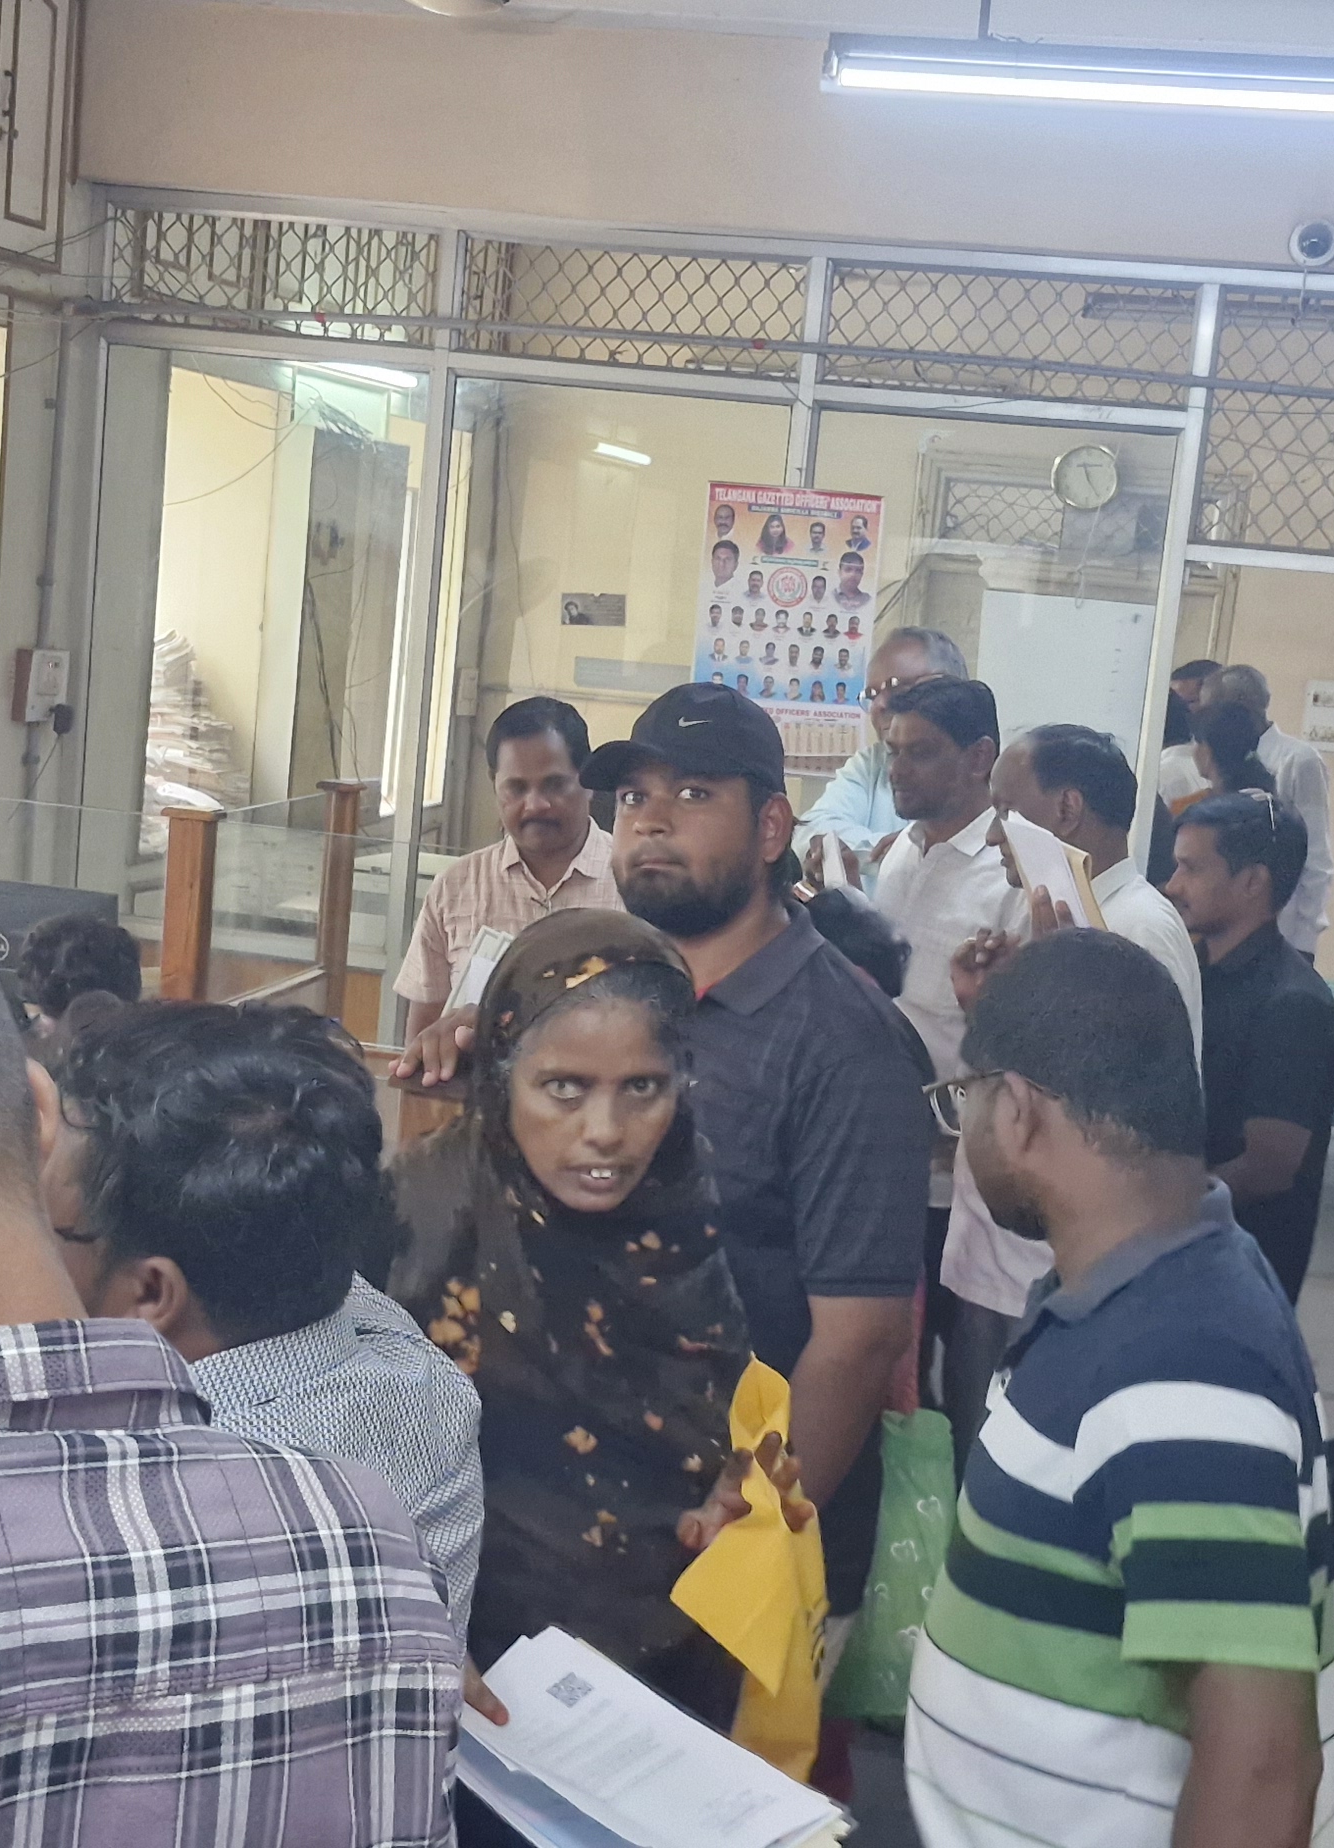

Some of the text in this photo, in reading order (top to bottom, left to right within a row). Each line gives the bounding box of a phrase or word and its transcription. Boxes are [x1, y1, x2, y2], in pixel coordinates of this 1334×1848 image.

[715, 487, 756, 503] TELANGANA
[757, 490, 794, 506] GAZETTED
[830, 496, 877, 514] ASSOCIATION
[813, 710, 861, 719] ASSOCIATION
